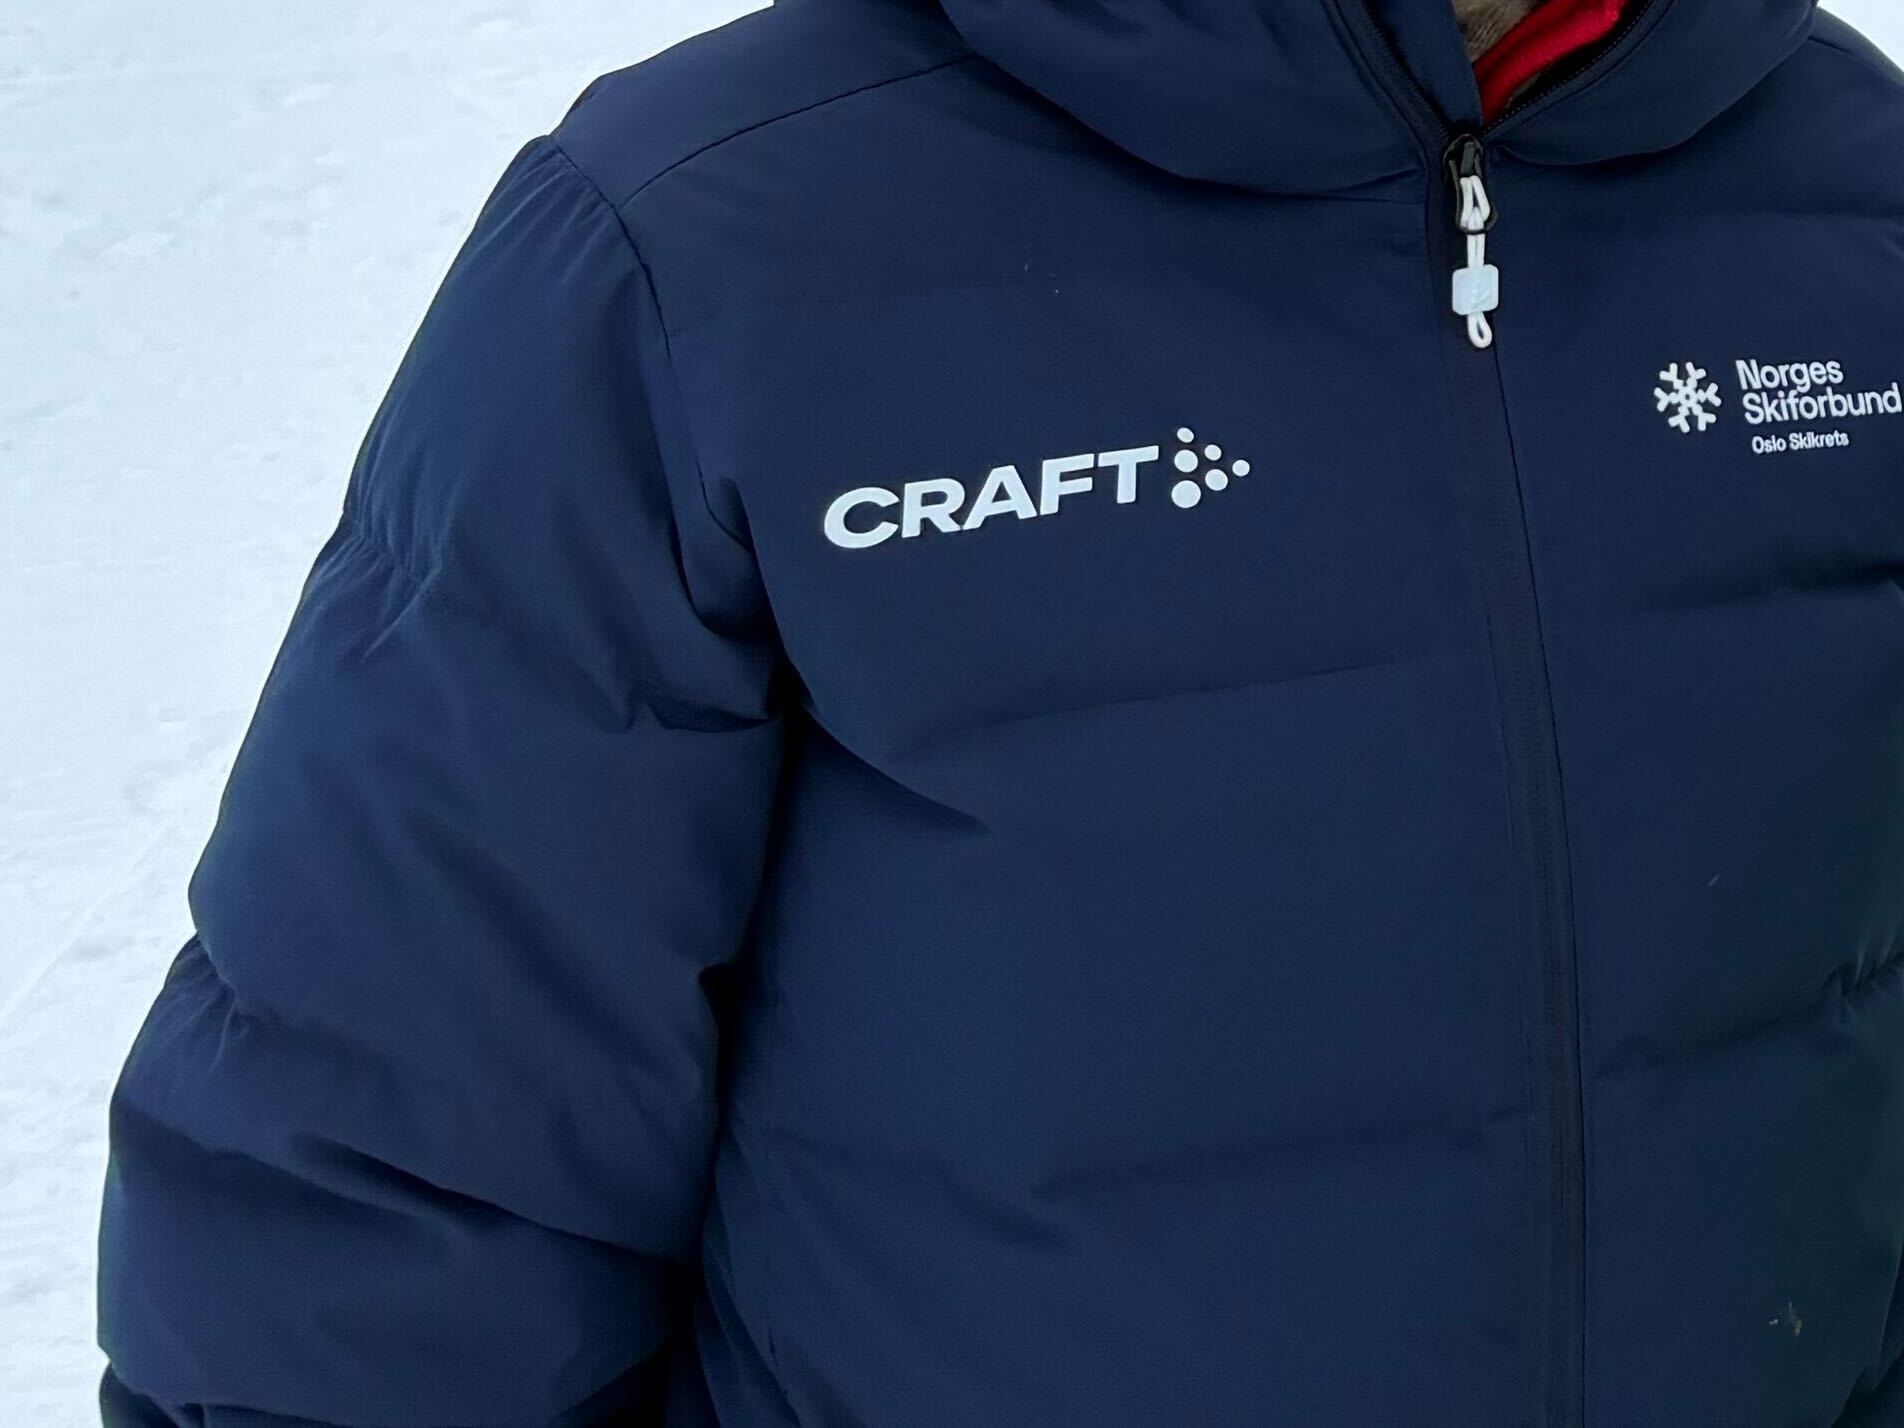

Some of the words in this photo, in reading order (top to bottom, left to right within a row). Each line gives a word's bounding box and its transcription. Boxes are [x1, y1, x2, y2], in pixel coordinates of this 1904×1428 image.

[1735, 358, 1844, 393] Norges
[1742, 382, 1904, 425] Skiforbund
[1751, 434, 1787, 455] Oslo
[1789, 430, 1850, 452] Skikrets
[823, 444, 1160, 550] CRAFT
